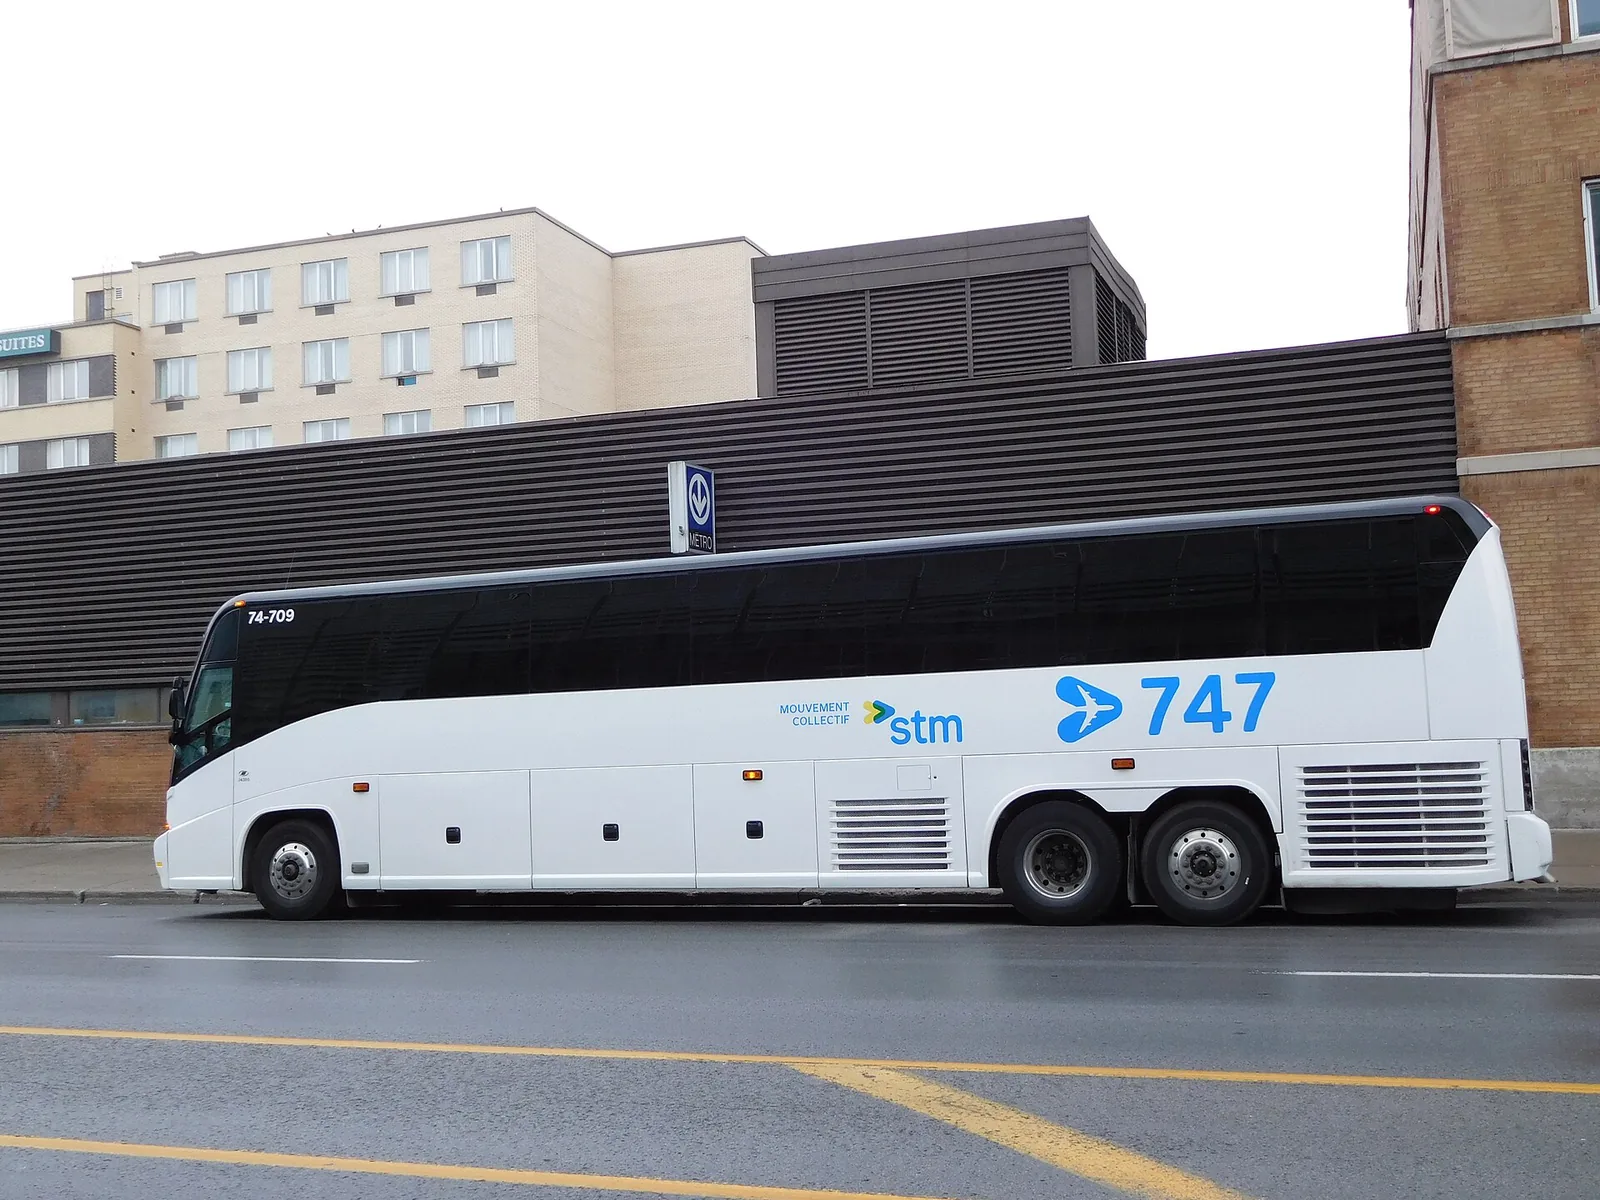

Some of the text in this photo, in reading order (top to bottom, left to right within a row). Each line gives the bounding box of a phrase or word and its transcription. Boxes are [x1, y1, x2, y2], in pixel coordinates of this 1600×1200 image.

[0, 334, 45, 351] UITES
[248, 608, 295, 625] 74-709
[780, 702, 849, 714] MOUVEMENT
[1141, 672, 1276, 735] 747
[792, 715, 850, 727] COLLECTIF
[890, 710, 963, 745] stm
